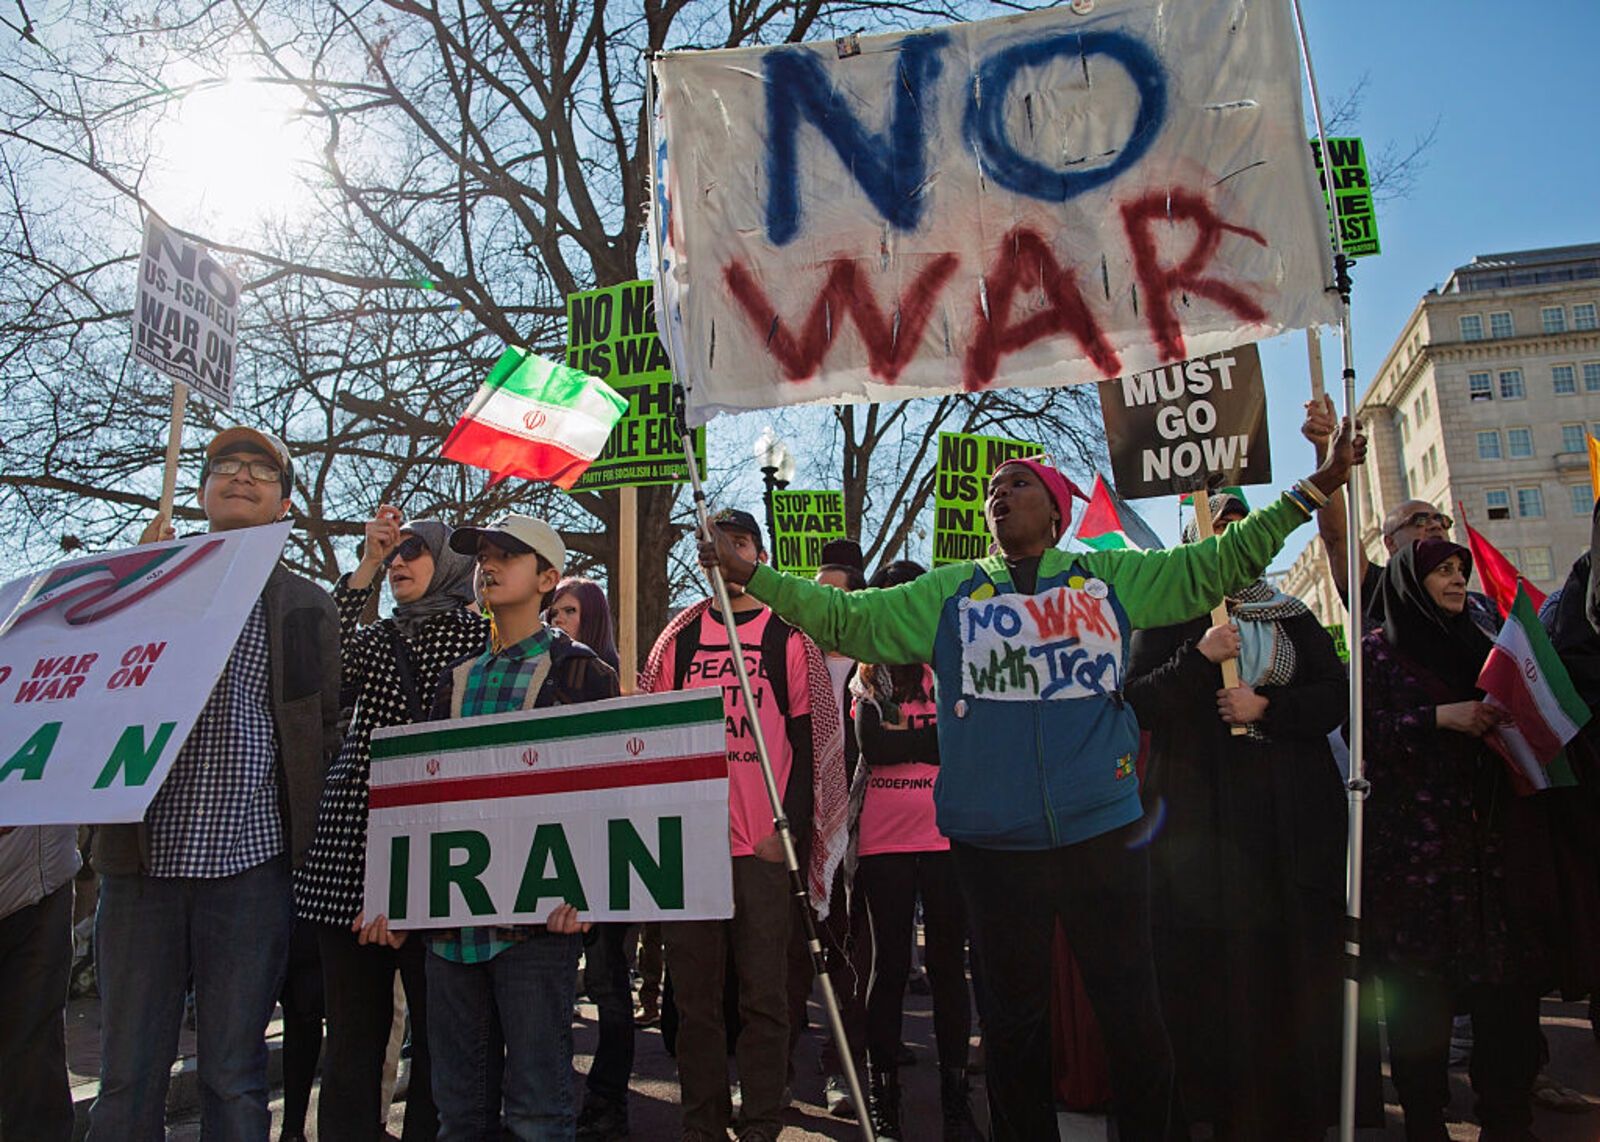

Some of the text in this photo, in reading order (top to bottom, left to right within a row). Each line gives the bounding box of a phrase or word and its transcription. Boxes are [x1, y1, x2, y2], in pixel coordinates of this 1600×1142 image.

[763, 29, 1168, 246] NO
[1310, 140, 1360, 168] EW
[1319, 168, 1367, 191] AR
[146, 222, 237, 308] NO
[144, 258, 235, 337] US-ISRAELI
[724, 188, 1267, 390] WAR
[141, 291, 232, 374] WAR ON
[571, 285, 659, 347] NO NE
[138, 323, 230, 394] IRAN!
[615, 337, 671, 376] WA
[1121, 357, 1237, 408] MUST
[646, 418, 698, 456] EAS
[1156, 399, 1218, 440] GO
[941, 436, 979, 474] NO
[1143, 434, 1249, 482] NOW!
[775, 494, 841, 513] STOP THE
[940, 475, 979, 502] US
[776, 514, 844, 533] WAR
[938, 507, 974, 532] IN
[779, 536, 825, 567] ON IR
[968, 586, 1118, 643] NO WAR
[32, 653, 98, 678] WAR
[121, 641, 167, 666] ON
[14, 665, 152, 703] WAR ON
[0, 721, 177, 789] AN
[871, 777, 933, 789] CODEPINK
[388, 816, 685, 920] IRAN
